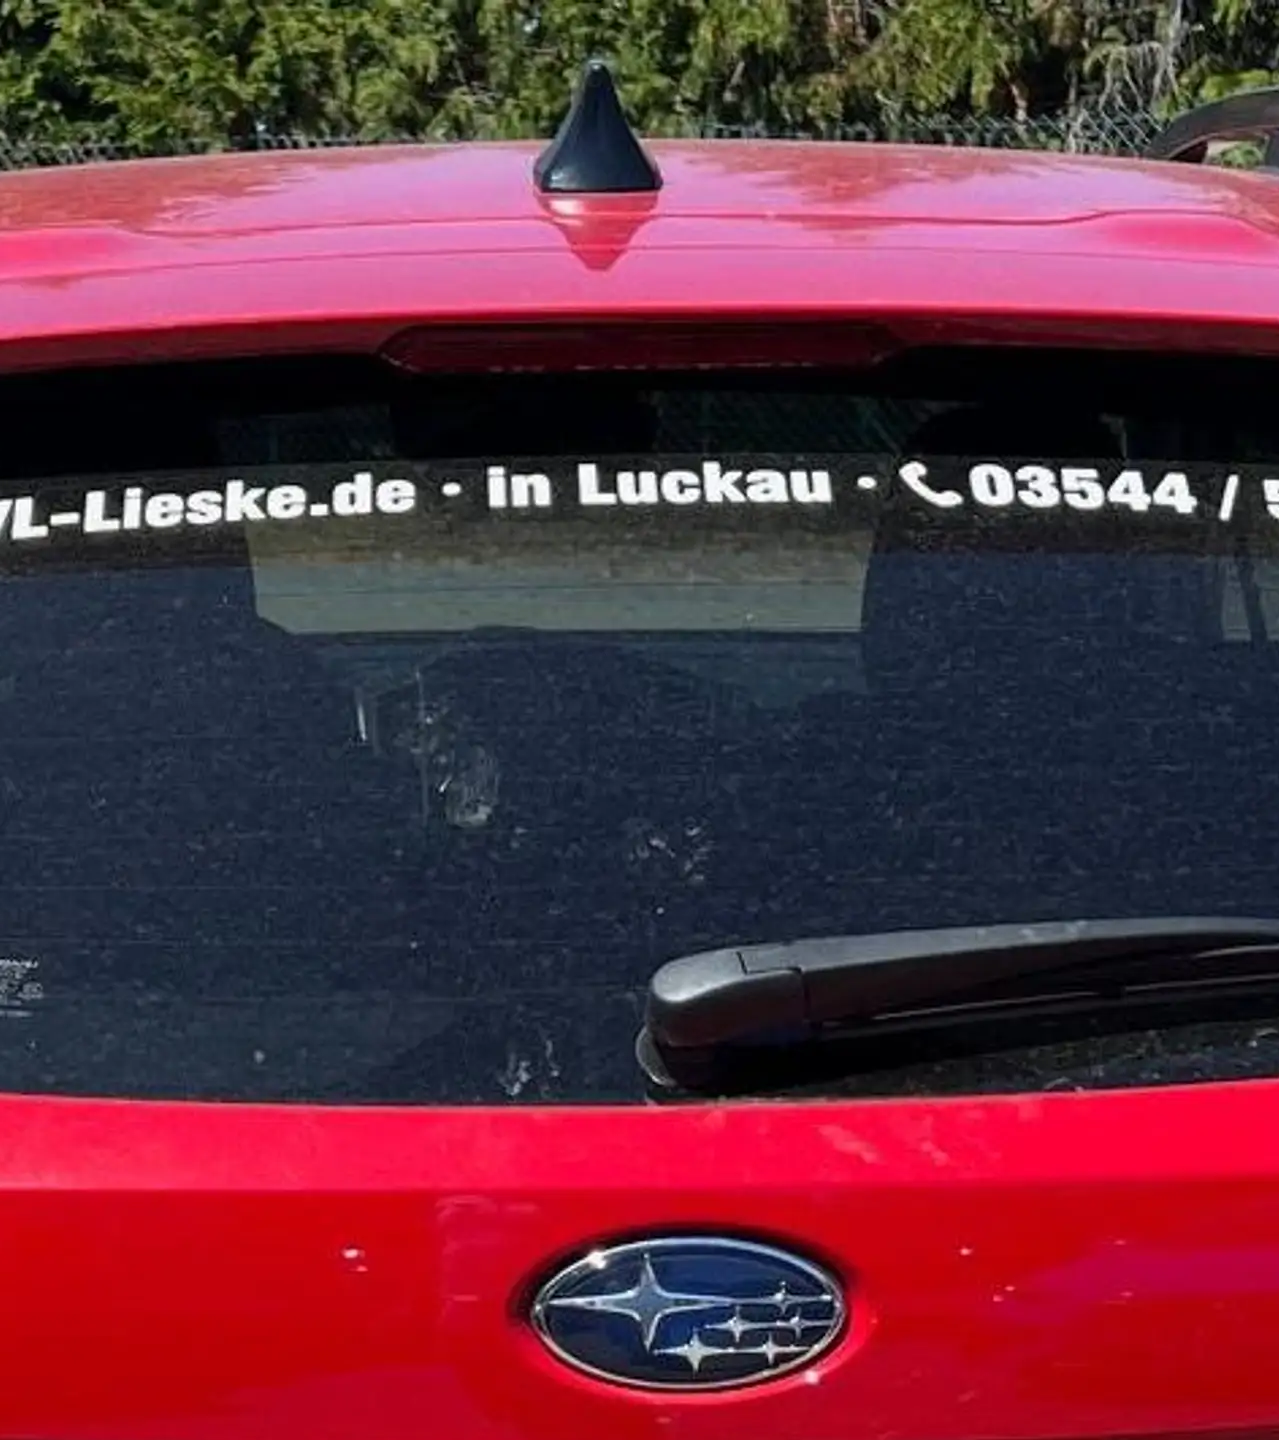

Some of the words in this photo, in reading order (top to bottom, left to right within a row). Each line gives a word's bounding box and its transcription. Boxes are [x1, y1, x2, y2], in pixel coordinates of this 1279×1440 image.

[486, 466, 551, 508] in
[577, 461, 832, 505] Luckau
[969, 464, 1198, 514] 03544
